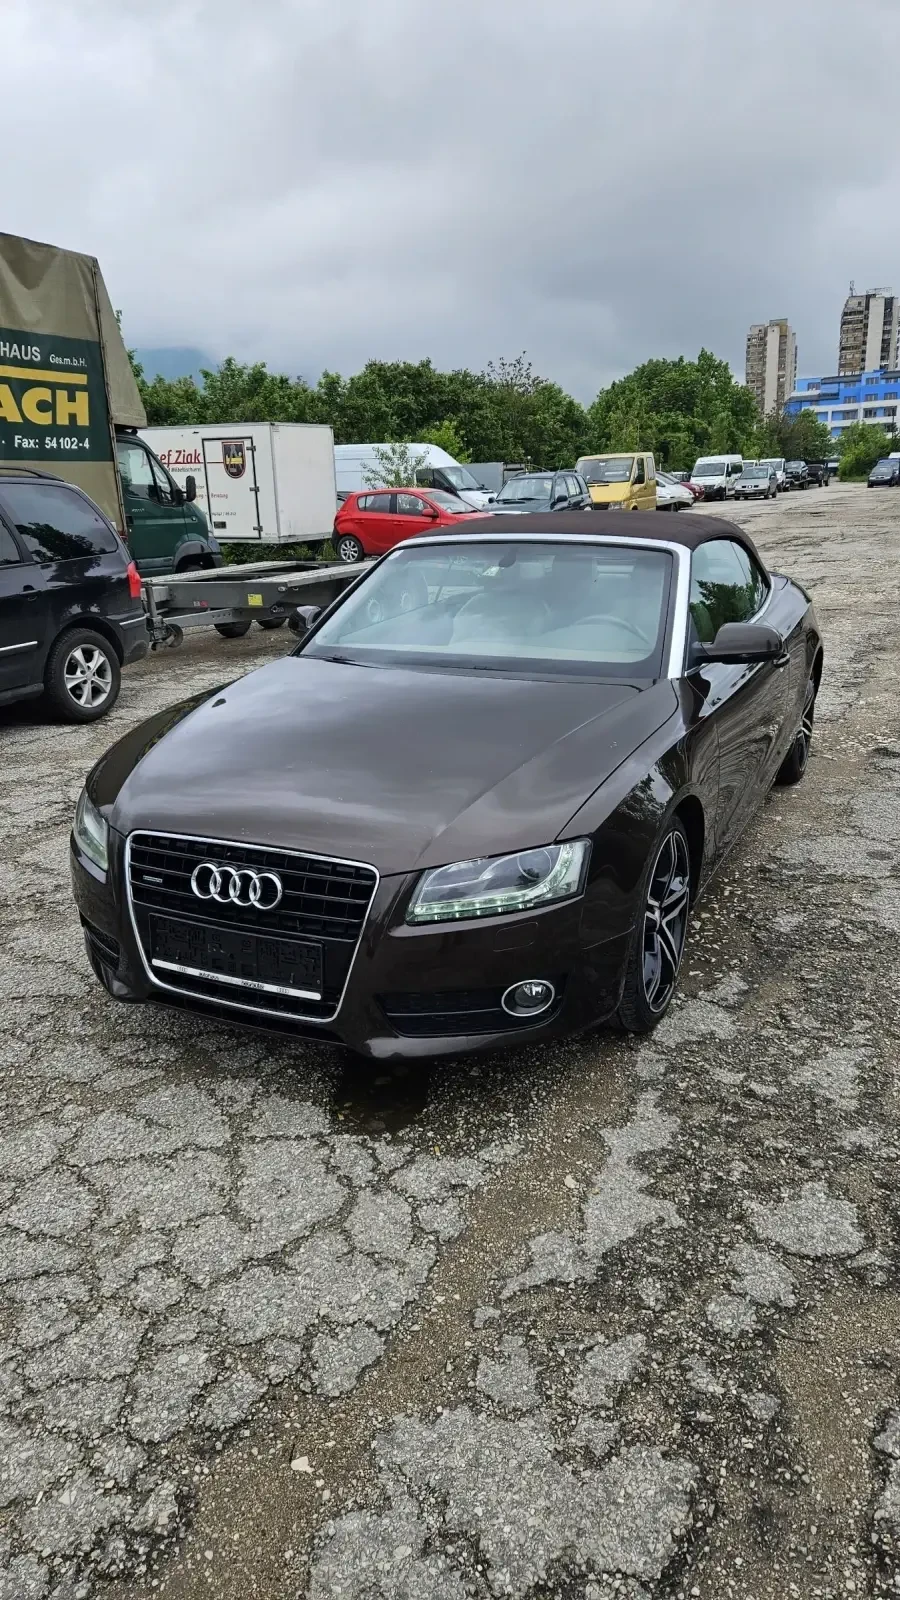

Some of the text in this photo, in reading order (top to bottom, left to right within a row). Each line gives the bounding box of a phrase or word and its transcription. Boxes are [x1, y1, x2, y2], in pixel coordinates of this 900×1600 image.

[0, 341, 41, 362] HAUS
[14, 434, 39, 448] Fax:
[175, 449, 201, 464] Ziak
